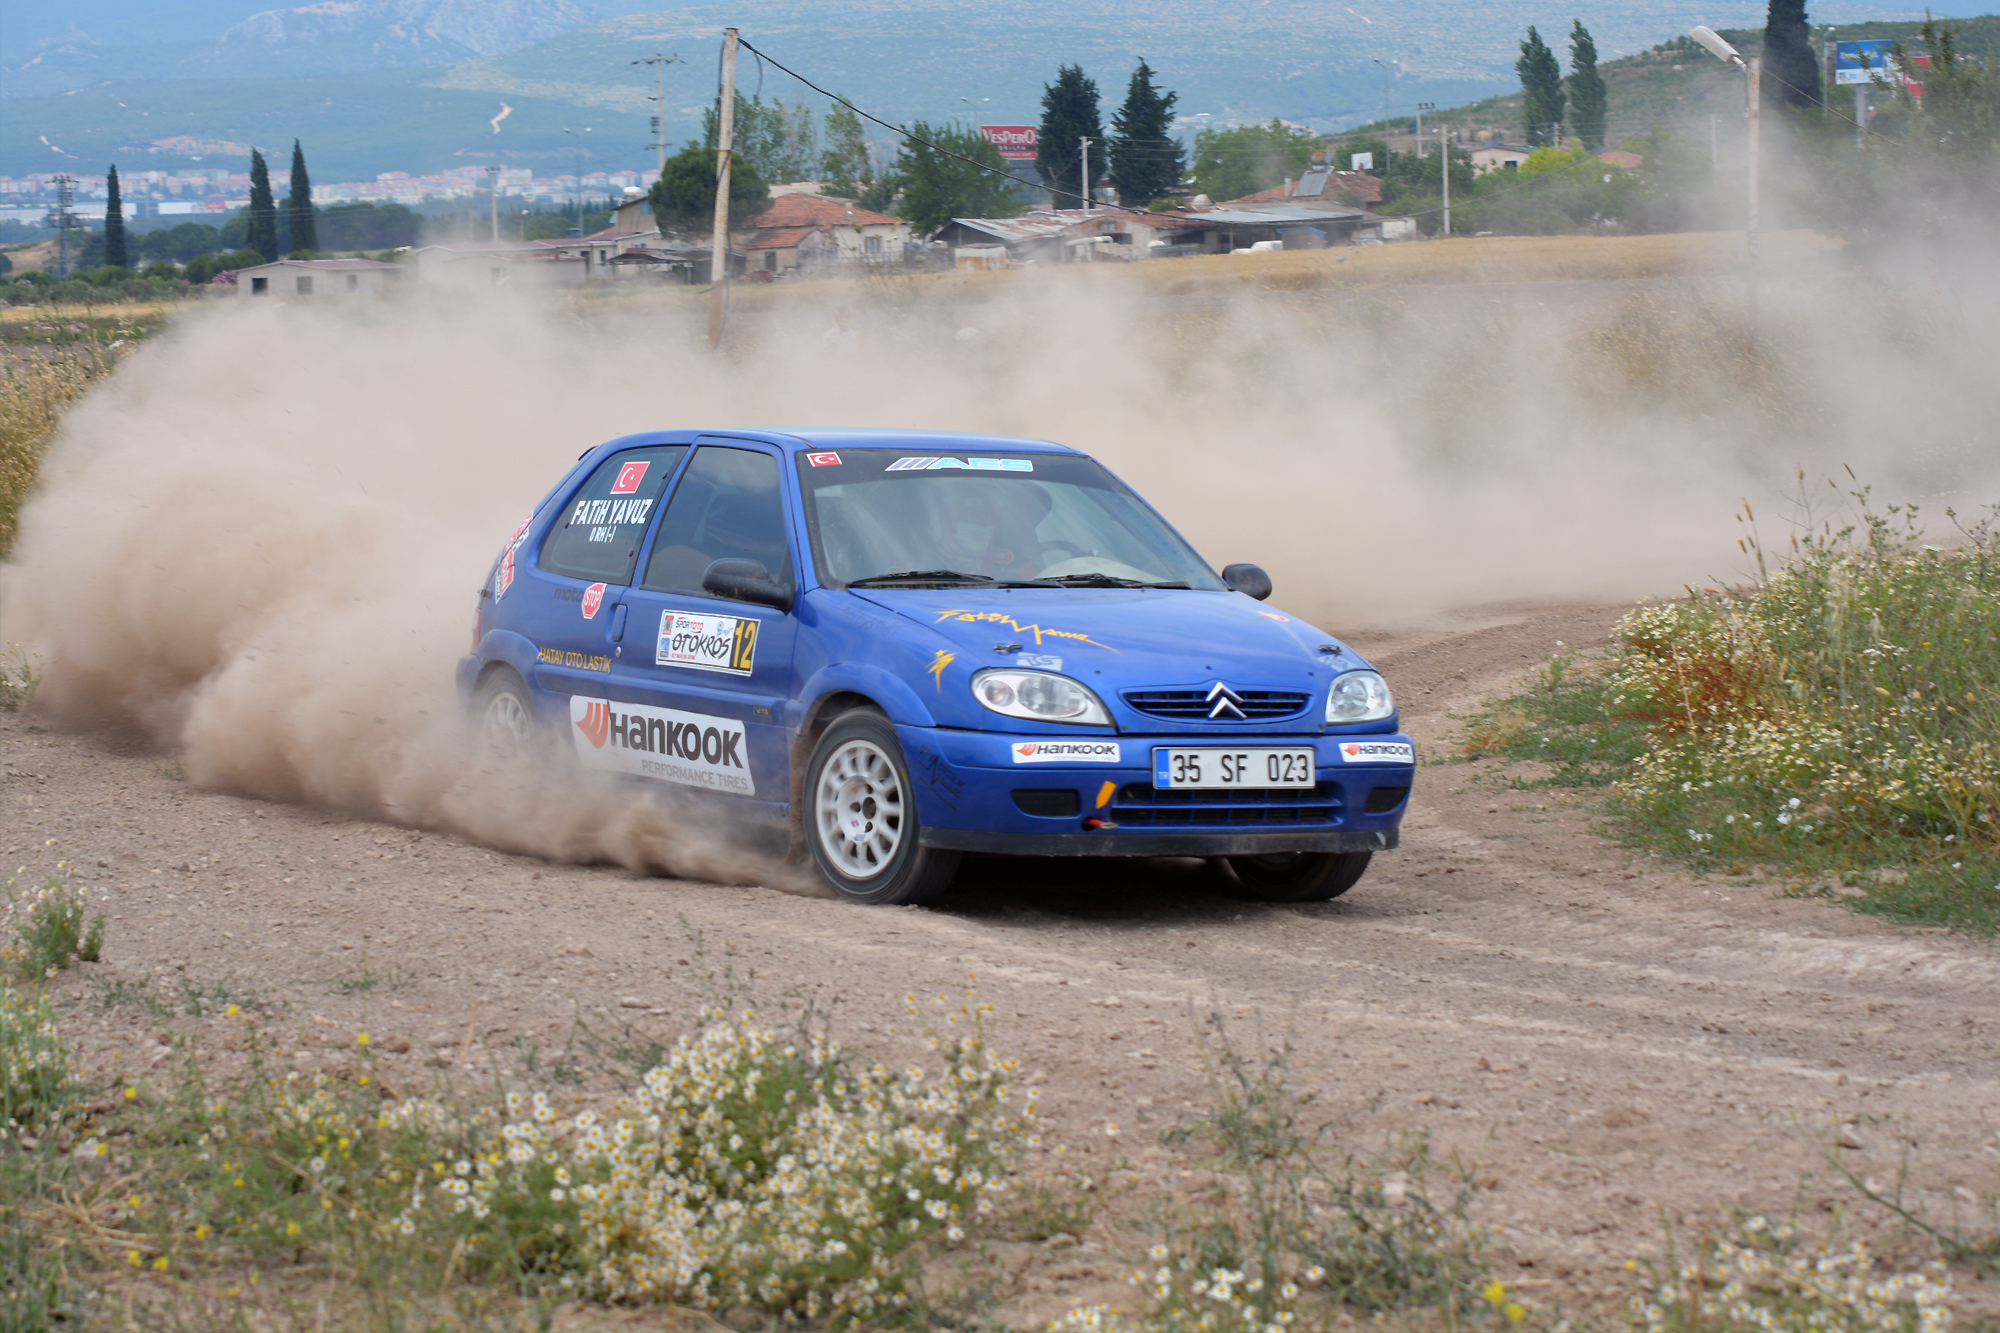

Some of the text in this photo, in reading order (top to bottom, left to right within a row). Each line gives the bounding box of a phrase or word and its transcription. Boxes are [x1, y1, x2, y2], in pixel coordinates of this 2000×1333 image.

[982, 129, 1035, 144] VESPERO
[608, 499, 653, 525] YAVUZ
[584, 589, 602, 608] STOP
[537, 648, 565, 665] HATAY
[565, 652, 583, 668] OTO
[672, 632, 731, 660] OTOKROS
[733, 620, 756, 670] 12
[641, 759, 749, 791] PERFORMANCE TIRES
[1173, 754, 1309, 783] 35 SF 023
